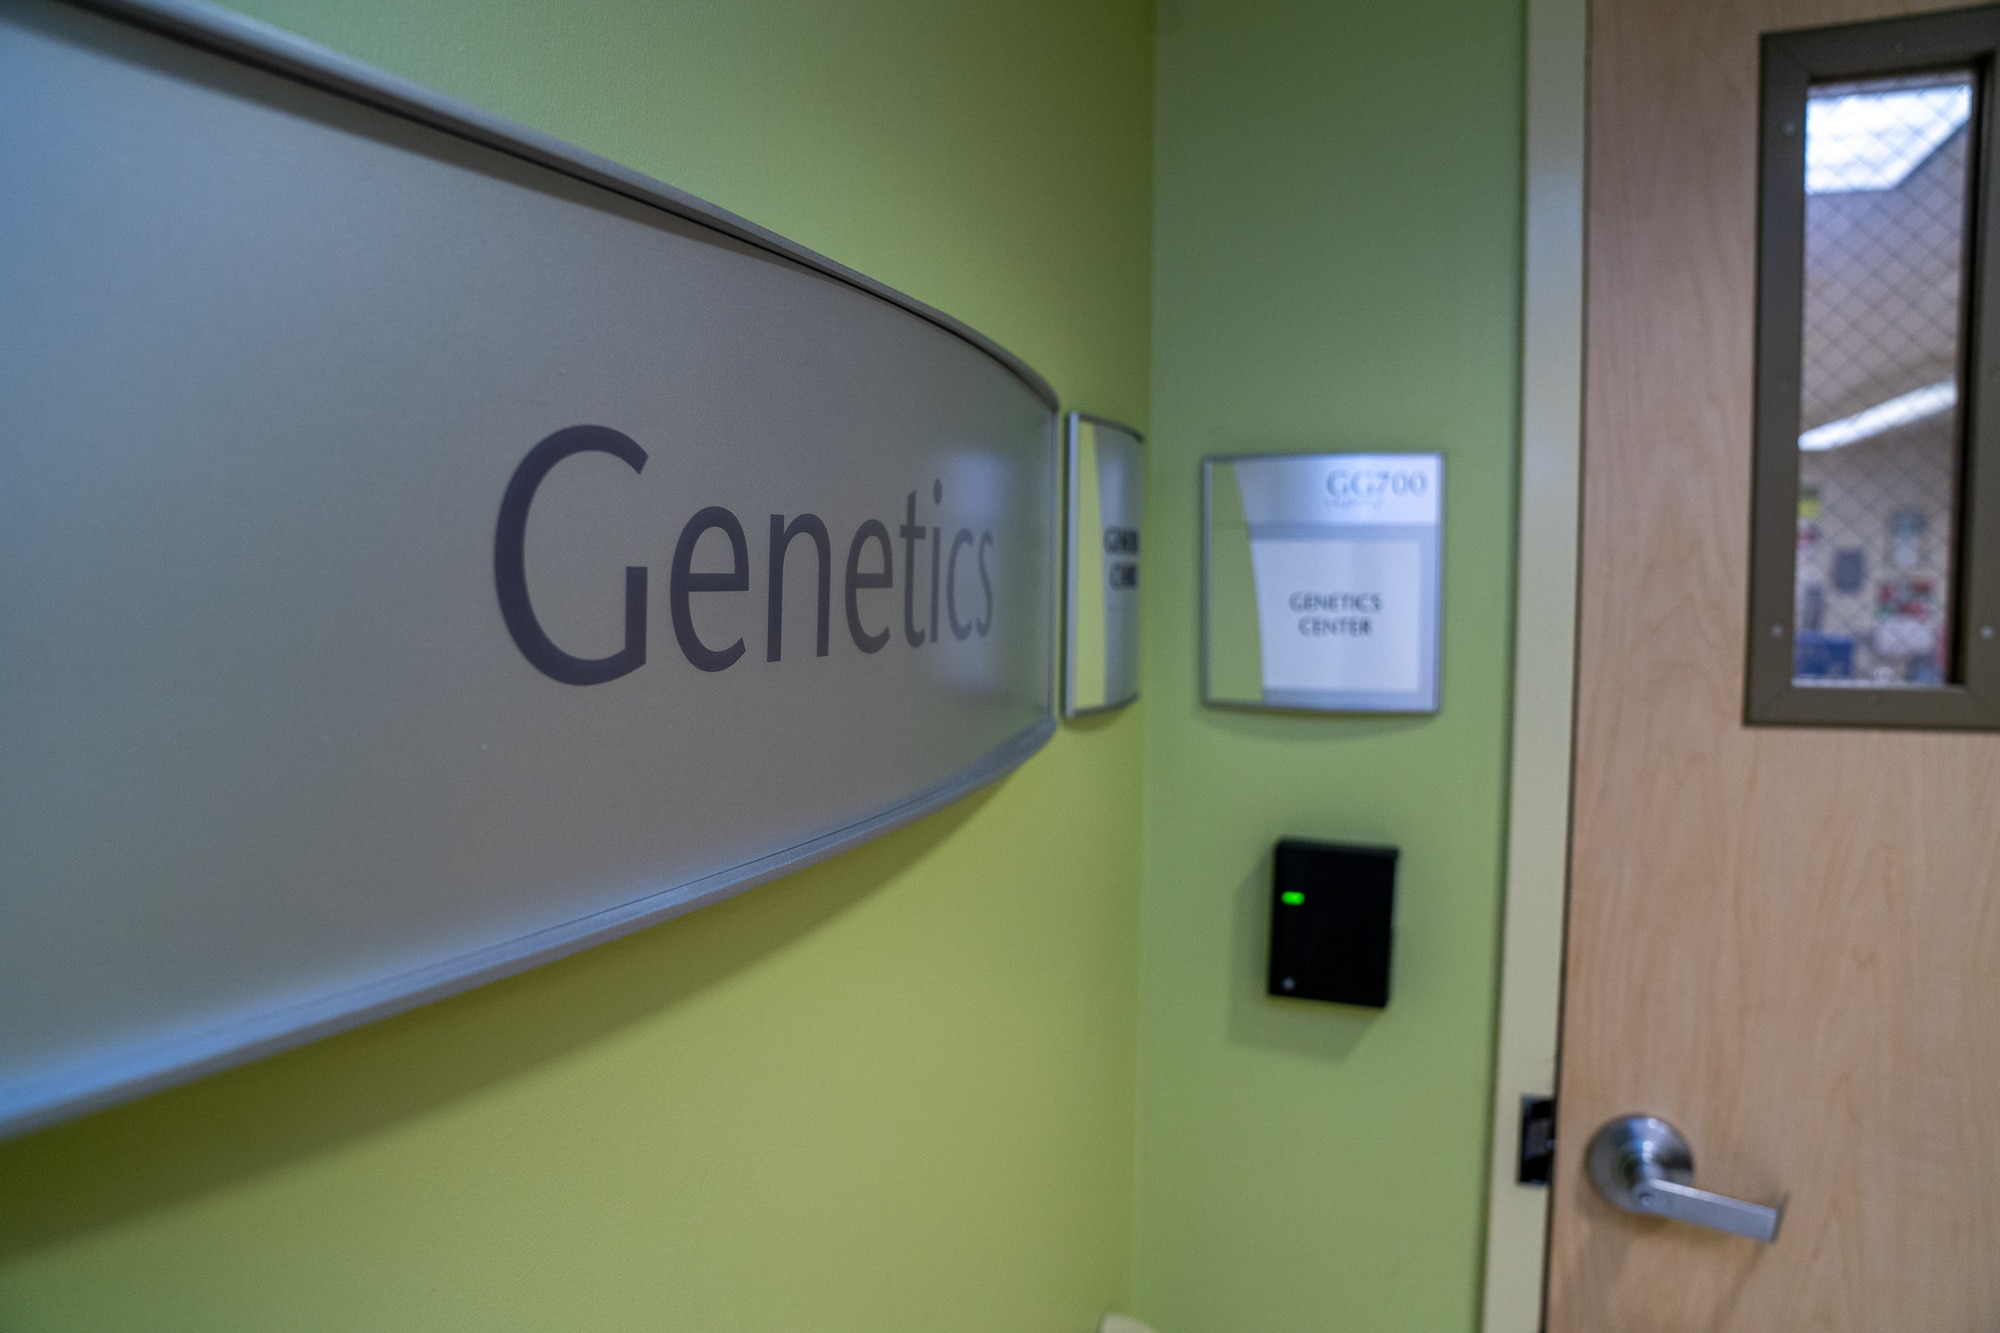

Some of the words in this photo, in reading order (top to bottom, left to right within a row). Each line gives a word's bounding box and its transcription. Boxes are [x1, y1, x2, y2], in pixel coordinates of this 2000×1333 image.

[1327, 470, 1428, 498] GG700
[494, 424, 993, 686] Genetics
[1289, 592, 1381, 613] GENETICS
[1299, 615, 1371, 637] CENTER
